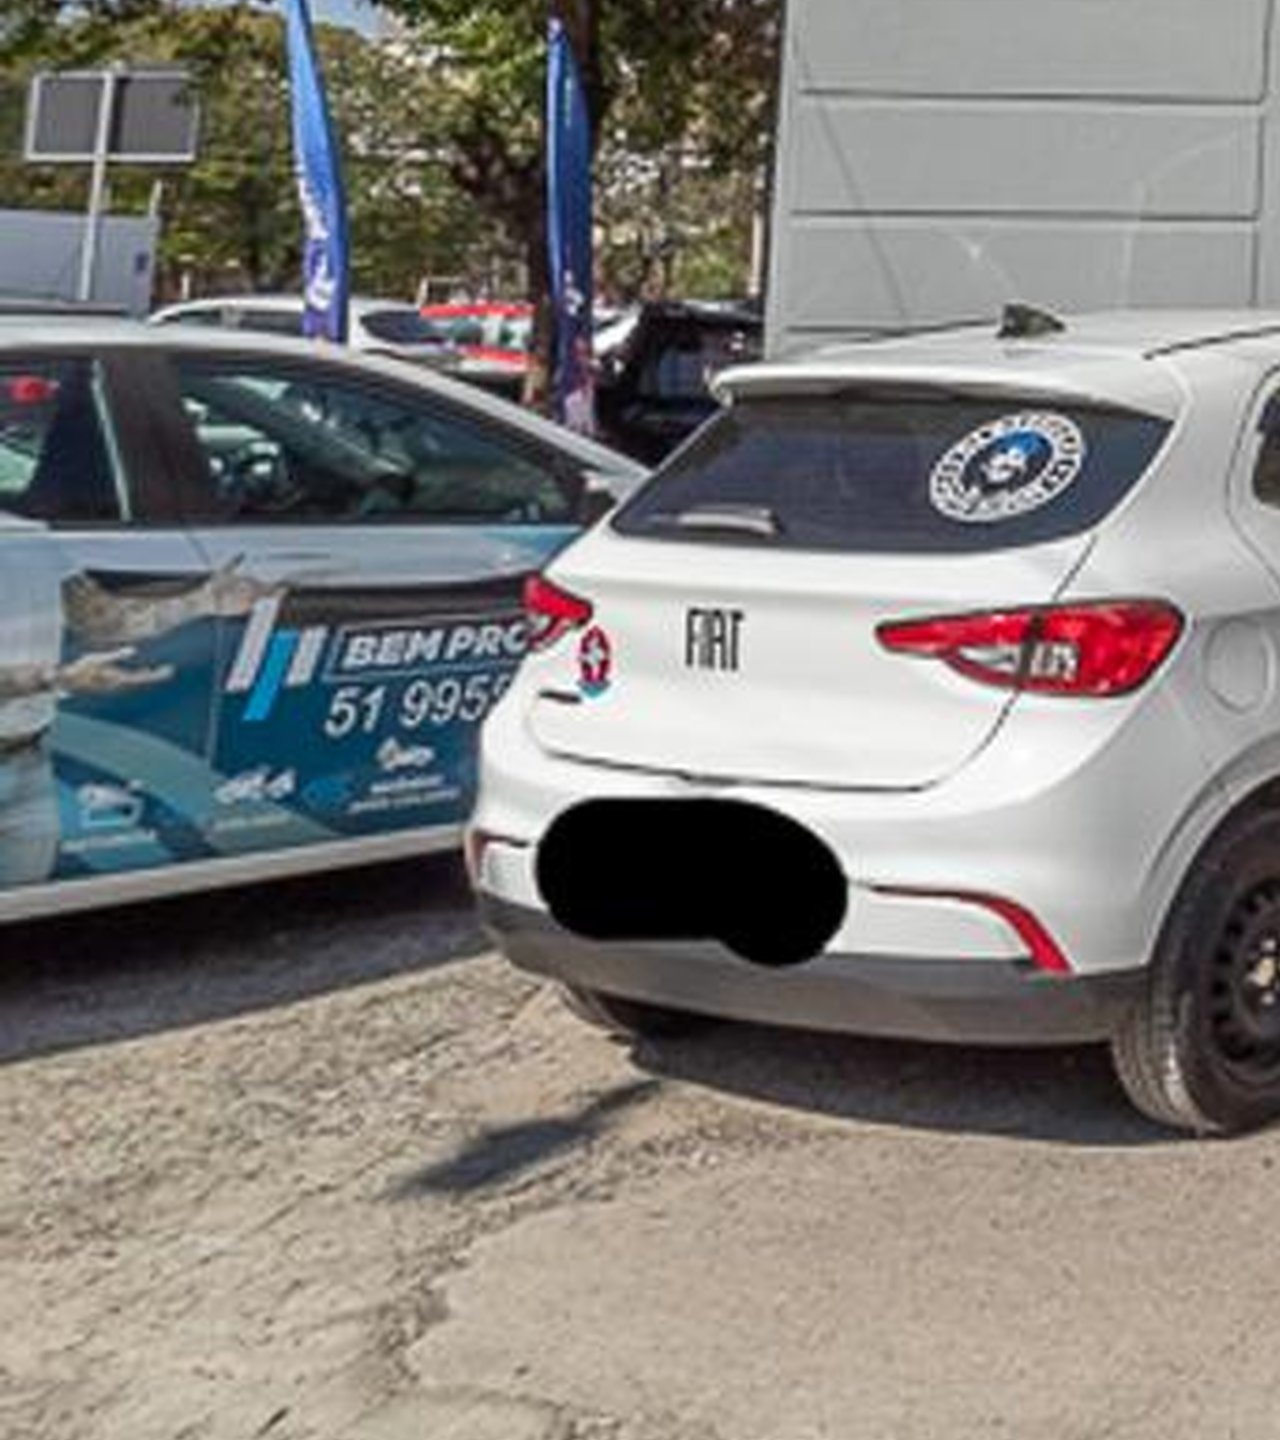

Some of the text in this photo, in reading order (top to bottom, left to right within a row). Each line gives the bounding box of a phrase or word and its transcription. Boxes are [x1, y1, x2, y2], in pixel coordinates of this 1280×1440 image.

[341, 628, 444, 669] BEM
[685, 608, 744, 672] FIAT
[324, 685, 386, 738] 51
